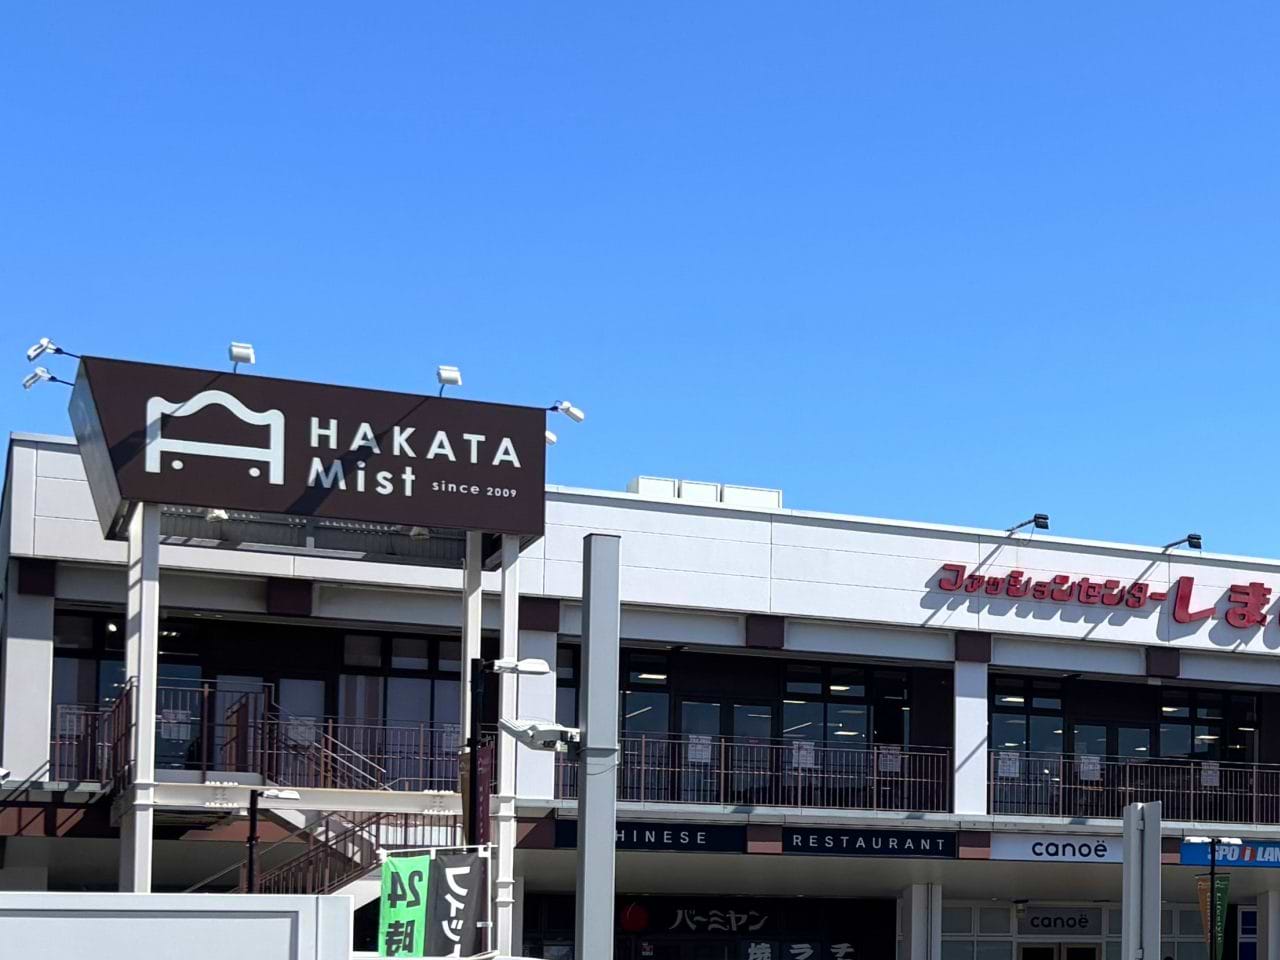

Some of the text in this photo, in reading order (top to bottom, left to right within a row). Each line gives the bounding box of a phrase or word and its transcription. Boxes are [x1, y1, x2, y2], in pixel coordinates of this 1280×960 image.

[310, 416, 522, 468] HAKATA
[307, 456, 517, 498] Mist since 2009
[615, 831, 946, 851] HINESE RESTAURANT
[1031, 840, 1108, 858] canoë
[668, 909, 769, 931] バーミヤン
[1030, 914, 1089, 929] canoë
